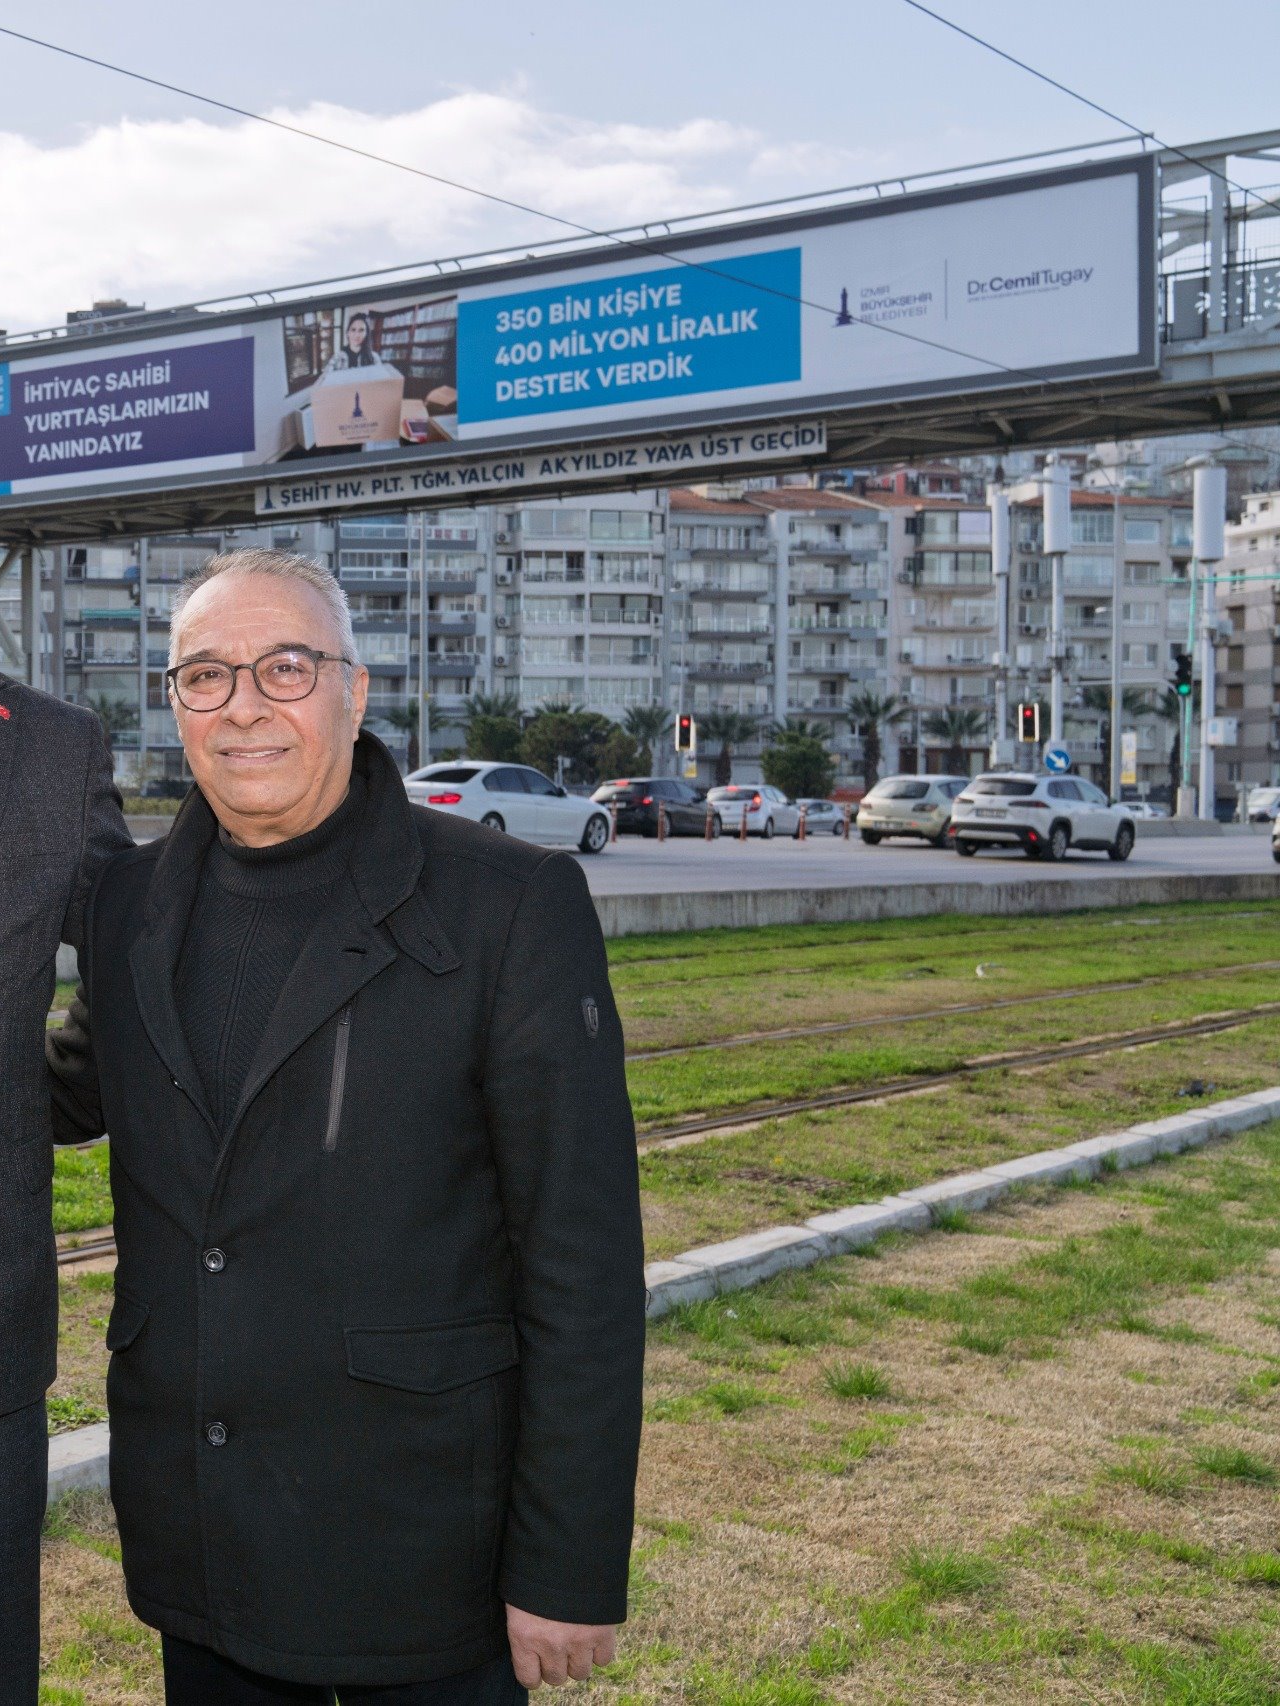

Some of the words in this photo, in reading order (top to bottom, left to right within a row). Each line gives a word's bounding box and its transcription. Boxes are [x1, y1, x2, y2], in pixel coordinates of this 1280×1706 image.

[495, 306, 542, 333] 350
[549, 296, 591, 325] BİN
[598, 284, 682, 318] KİŞİYE
[495, 341, 542, 367] 400
[549, 324, 650, 360] MİLYON
[656, 308, 759, 344] LİRALIK
[24, 375, 101, 404] İHTİYAÇ
[104, 359, 171, 392] SAHİBİ
[496, 369, 590, 402] DESTEK
[596, 352, 693, 388] VERDİK
[24, 390, 210, 434] YURTTAŞLARIMIZIN
[24, 431, 143, 464] YANINDAYIZ
[281, 482, 331, 508] ŞEHİT
[336, 480, 365, 499] HV.
[372, 475, 404, 495] PLT.
[457, 463, 525, 485] YALÇIN
[645, 443, 694, 464] YAYA
[701, 434, 743, 458] ÜST
[750, 422, 825, 451] GEÇİDİ
